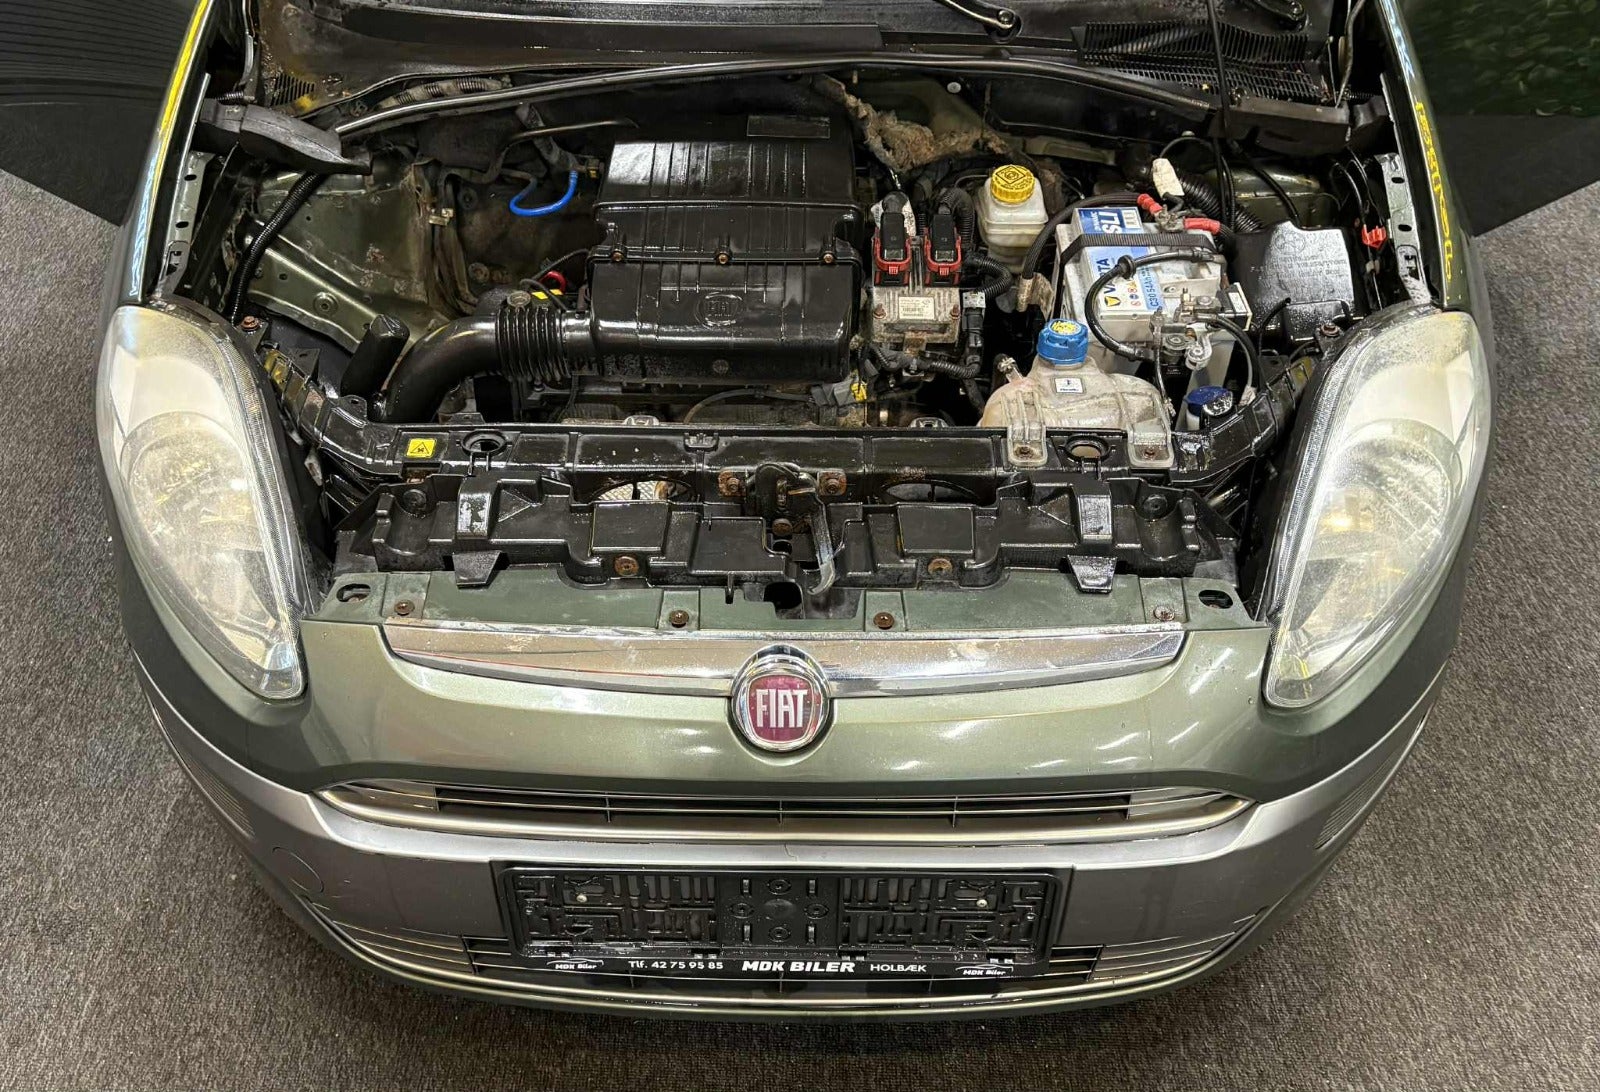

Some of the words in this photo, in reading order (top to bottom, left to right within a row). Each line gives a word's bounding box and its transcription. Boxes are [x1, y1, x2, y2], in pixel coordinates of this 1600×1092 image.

[1098, 211, 1122, 234] SLI
[1096, 258, 1116, 294] VTA
[756, 689, 808, 728] FIAT
[628, 960, 648, 969] Tlf.
[651, 961, 667, 969] 42
[670, 961, 686, 969] 75
[689, 961, 704, 969] 95
[708, 961, 723, 969] 85
[742, 961, 785, 972] MDK
[790, 961, 856, 973] BILER
[870, 964, 927, 973] HOLBÆK
